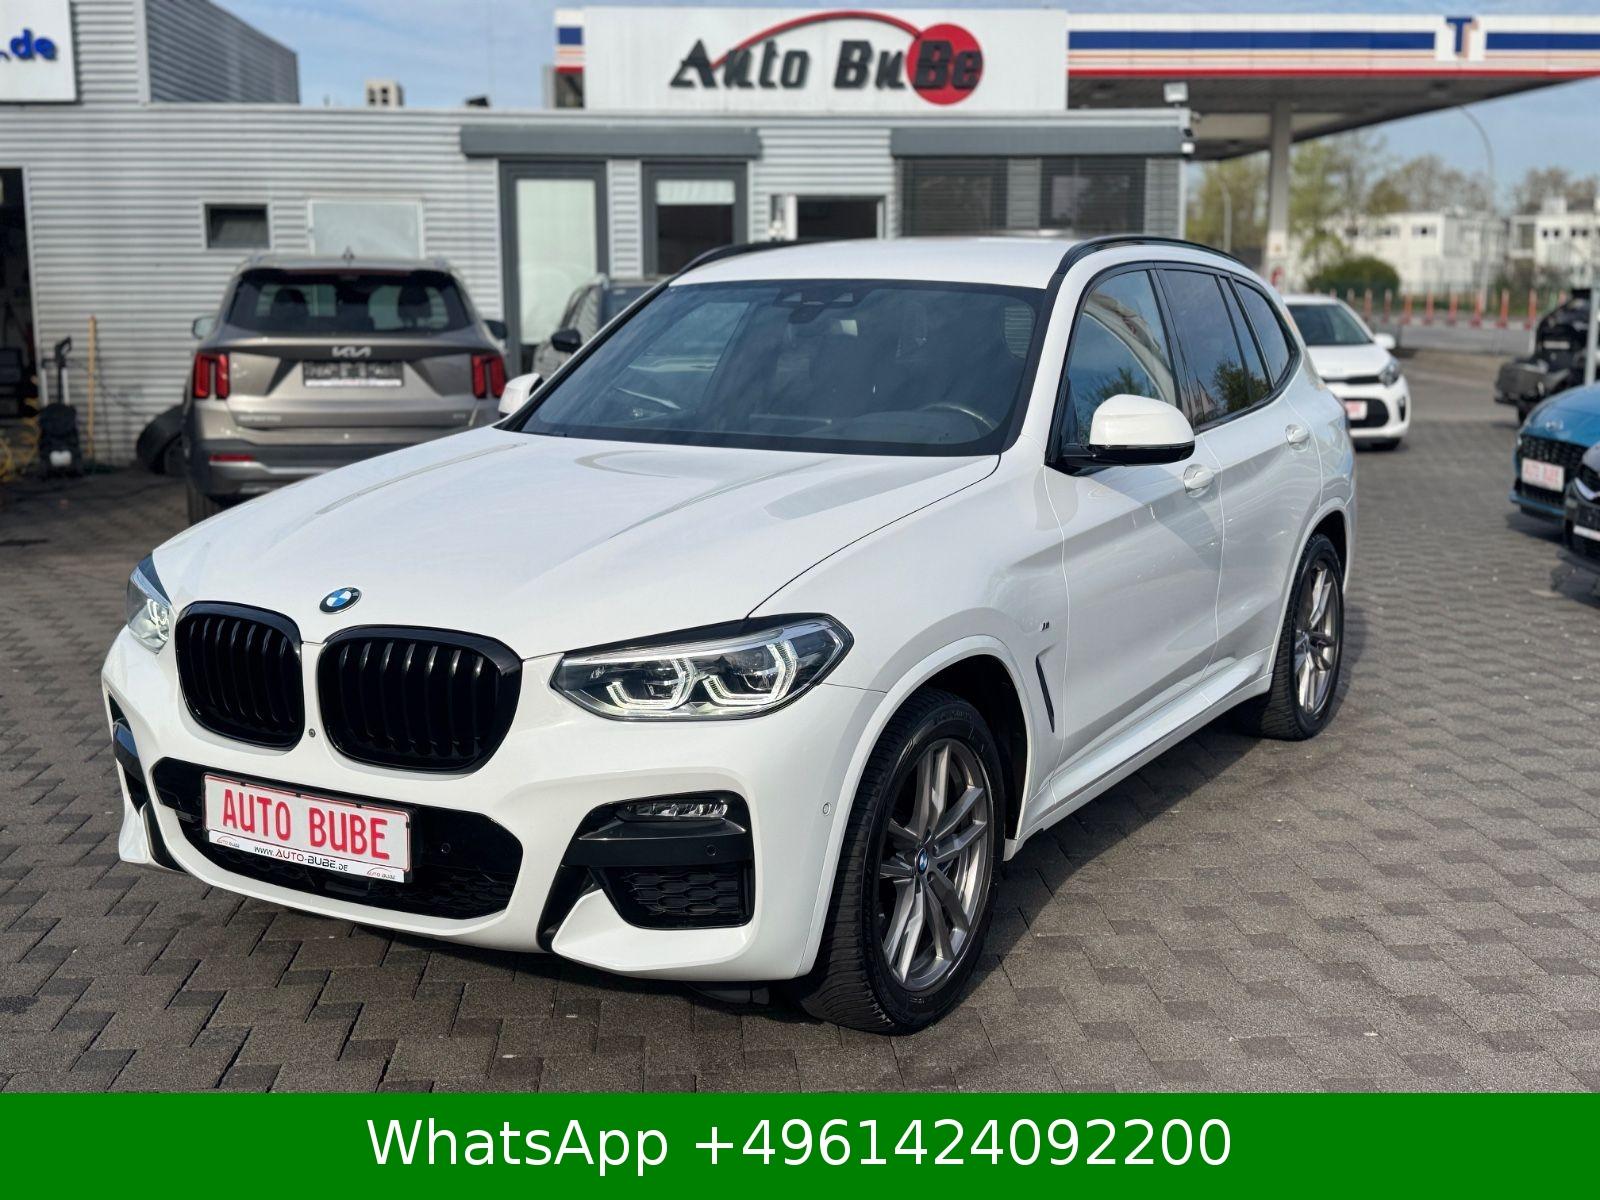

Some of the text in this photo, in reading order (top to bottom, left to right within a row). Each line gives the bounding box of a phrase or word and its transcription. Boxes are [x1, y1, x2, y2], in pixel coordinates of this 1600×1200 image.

[669, 39, 810, 89] Auto
[222, 788, 390, 861] AUTO BUBE
